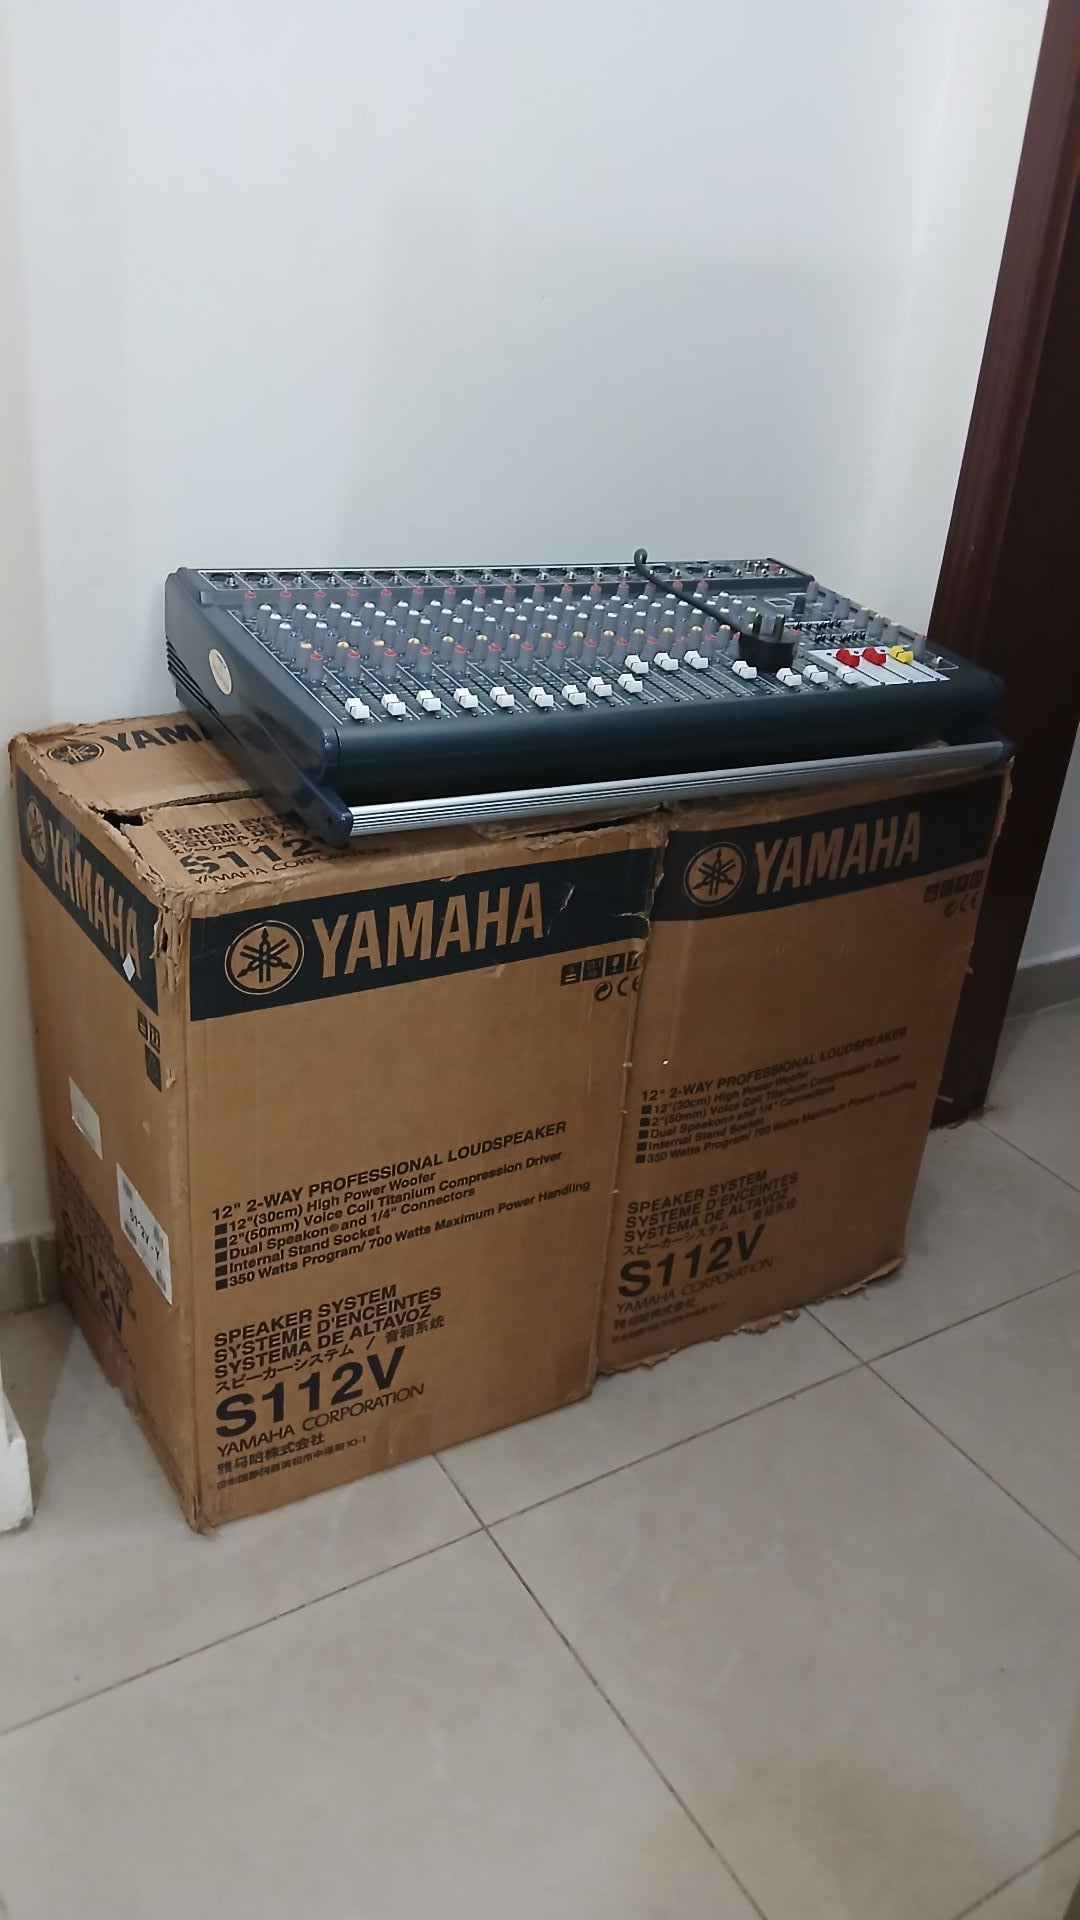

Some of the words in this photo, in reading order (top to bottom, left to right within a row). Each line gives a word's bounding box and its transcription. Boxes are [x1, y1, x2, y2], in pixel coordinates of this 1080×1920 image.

[99, 722, 212, 752] YAM
[195, 867, 269, 884] YAMAHA
[754, 811, 922, 896] YAMAHA
[47, 819, 142, 980] YAMAHA
[311, 881, 545, 981] YAMAHA
[641, 1088, 665, 1102] 12"
[669, 1079, 714, 1098] 2-WAY
[717, 1054, 816, 1089] PROFESSIONAL
[820, 1026, 908, 1062] LOUDSPEAKER
[648, 1135, 692, 1150] Internal
[695, 1127, 727, 1142] Stand
[650, 1126, 677, 1139] Dual
[710, 1102, 740, 1115] Voice
[212, 1202, 241, 1221] 12"
[246, 1187, 304, 1213] 2-WAY
[308, 1152, 444, 1198] PROFESSIONAL
[447, 1120, 567, 1163] LOUDSPEAKER
[670, 1145, 701, 1158] Watts
[228, 1219, 300, 1247] 2"(50mm)
[304, 1209, 343, 1226] Voice
[347, 1199, 375, 1216] Coil
[377, 1187, 436, 1207] Titanium
[438, 1163, 523, 1192] Compression
[525, 1151, 563, 1169] Driver
[229, 1204, 303, 1232] 12"(30cm)
[307, 1196, 340, 1213] High
[344, 1184, 387, 1203] Power
[389, 1170, 437, 1191] Woofer
[229, 1241, 263, 1260] Dual
[340, 1214, 367, 1231] and
[371, 1206, 397, 1223] 1/4"
[400, 1186, 476, 1215] Connectors
[623, 1215, 699, 1244] SYSTEMA
[704, 1209, 725, 1226] DE
[727, 1187, 790, 1217] ALTAVOZ
[625, 1200, 701, 1229] SYSTEME
[627, 1188, 705, 1215] SPEAKER
[708, 1169, 768, 1198] SYSTEM
[228, 1271, 256, 1287] 350
[257, 1261, 299, 1279] Watts
[302, 1241, 366, 1268] Program/
[368, 1235, 392, 1250] 700
[395, 1223, 432, 1243] Watts
[434, 1206, 495, 1232] Maximum
[498, 1194, 536, 1214] Power
[537, 1180, 591, 1202] Handling
[229, 1252, 285, 1274] Internal
[288, 1238, 330, 1258] Stand
[333, 1225, 381, 1246] Socket
[617, 1223, 766, 1298] S112V
[214, 1308, 313, 1348] SPEAKER
[317, 1284, 397, 1319] SYSTEM
[616, 1286, 676, 1314] YAMAHA
[681, 1256, 775, 1297] CORPORATION
[214, 1324, 312, 1364] SYSTEME
[317, 1286, 442, 1334] D'ENCEINTES
[214, 1339, 312, 1379] SYSTEMA
[317, 1329, 344, 1350] DE
[349, 1303, 432, 1341] ALTAVOZ
[215, 1345, 355, 1394] スピーカーシステム
[215, 1345, 406, 1438] S112V
[217, 1424, 296, 1458] YAMAHA
[302, 1383, 425, 1432] CORPORATION
